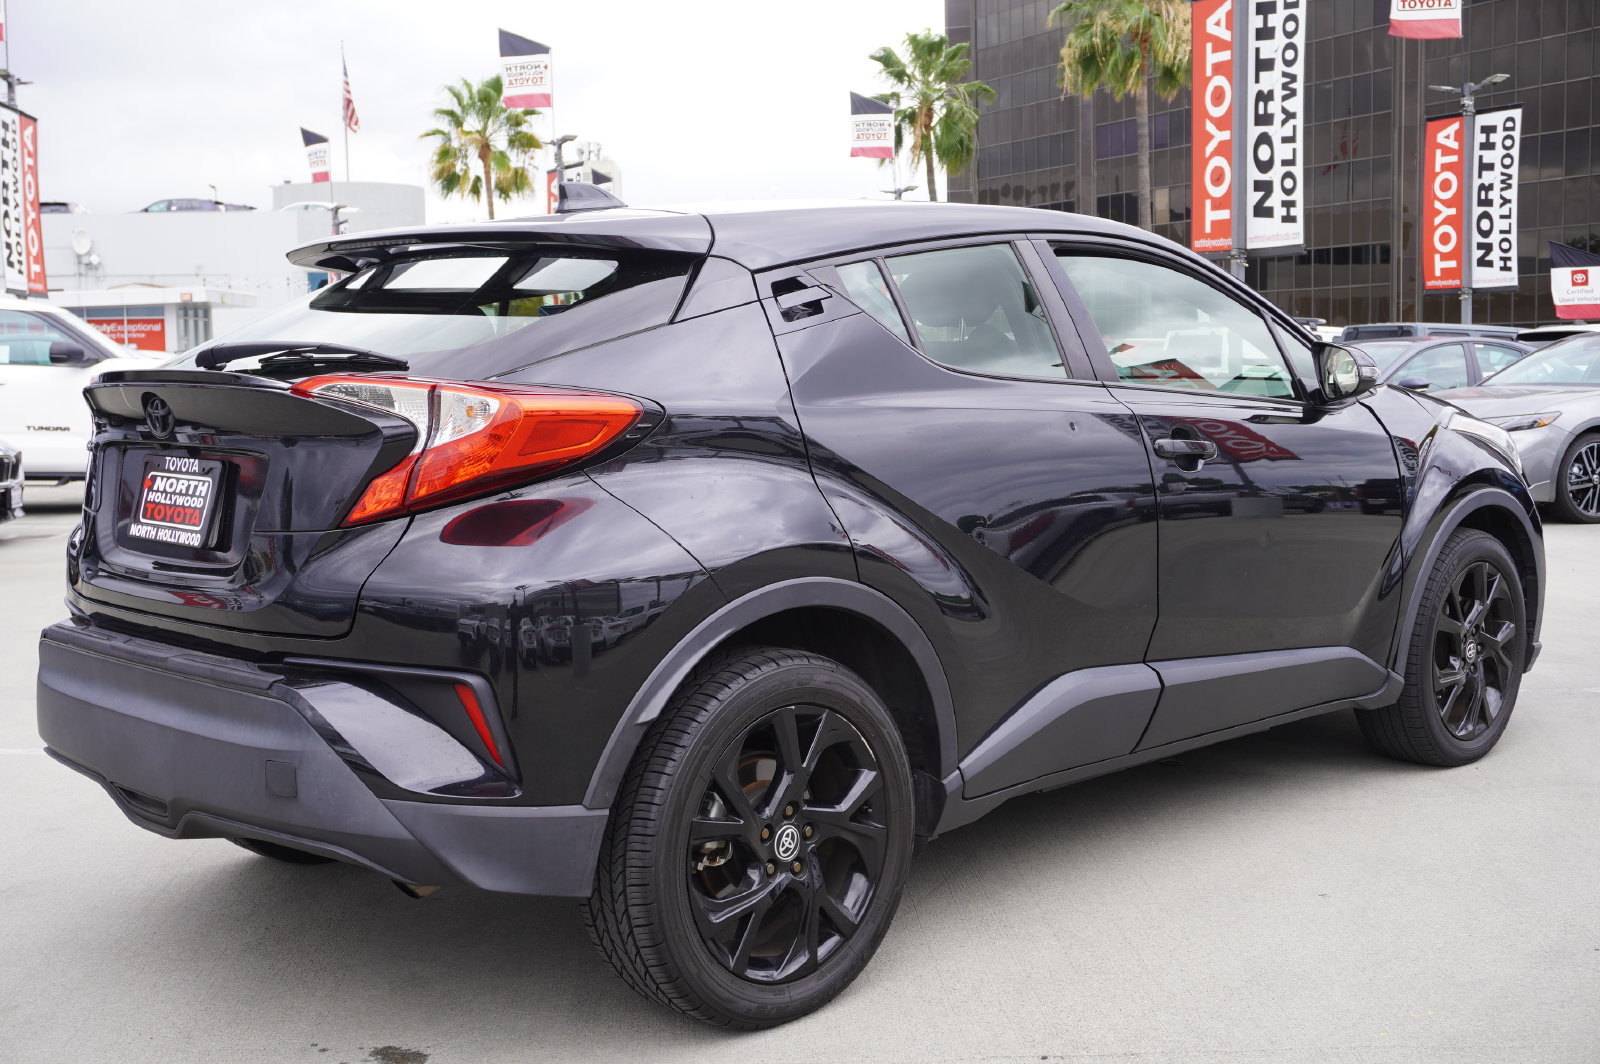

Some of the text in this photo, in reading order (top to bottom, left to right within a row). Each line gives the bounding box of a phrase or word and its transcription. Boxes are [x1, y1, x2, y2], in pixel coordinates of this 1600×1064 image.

[1204, 0, 1231, 233] TOYOTA
[1253, 1, 1277, 218] NORTH
[2, 120, 15, 269] NORTH
[11, 119, 24, 275] HOLLYWOOD
[24, 125, 41, 279] TOYOTA
[1433, 121, 1460, 276] TOYOTA
[1476, 125, 1497, 268] NORTH
[1499, 116, 1516, 272] HOLLYWOOD
[130, 523, 201, 546] NORTH HOLLYWOOD
[145, 503, 200, 525] TOYOTA
[147, 491, 204, 508] HOLLYWOOD
[153, 476, 209, 496] NORTH
[165, 456, 199, 472] TOYOTA
